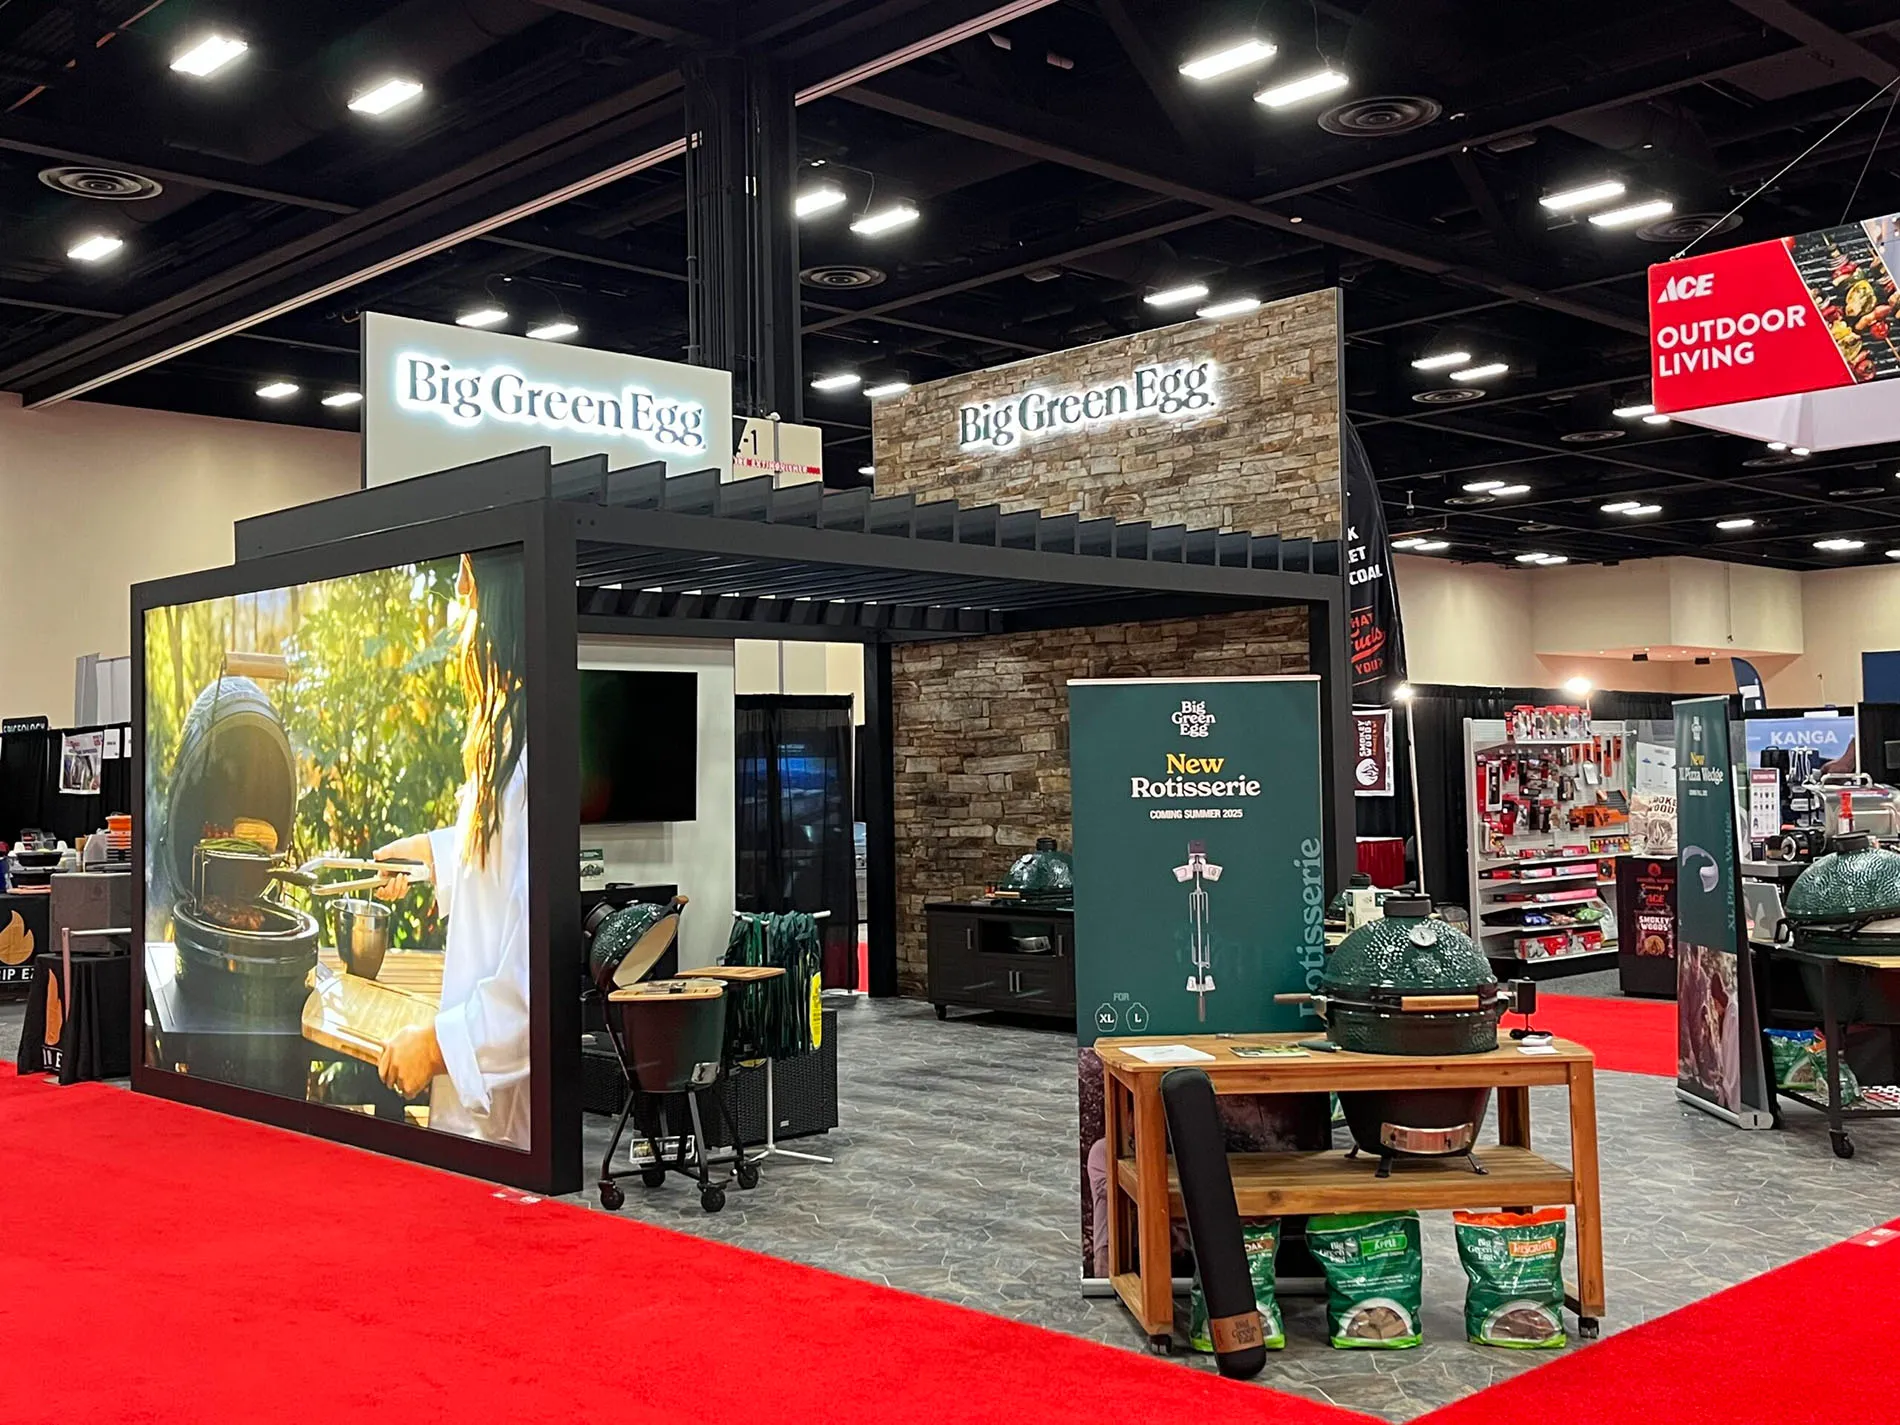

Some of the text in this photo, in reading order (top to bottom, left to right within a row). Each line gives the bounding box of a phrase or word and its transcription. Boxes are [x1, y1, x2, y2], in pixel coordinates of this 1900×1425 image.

[1657, 273, 1715, 304] ACE
[1657, 305, 1806, 349] OUTDOOR
[1659, 342, 1755, 378] LIVING
[408, 359, 705, 449] Big Green Egg
[960, 363, 1209, 446] Big Green Egg
[1348, 546, 1366, 564] ET
[1350, 564, 1383, 586] COAL
[1181, 701, 1206, 715] Big
[1171, 712, 1217, 725] Green
[1179, 723, 1210, 737] Egg
[1770, 730, 1838, 746] KANGA
[1166, 753, 1225, 775] New
[1131, 775, 1261, 799] Rotisserie
[1150, 809, 1243, 820] COMING SUMMER 2025
[1295, 836, 1325, 1018] otisserie
[1639, 915, 1670, 924] SMOKEY
[1640, 923, 1668, 932] WOODS
[0, 968, 16, 981] IP
[1113, 993, 1130, 1001] FOR
[1100, 1013, 1142, 1023] XL L
